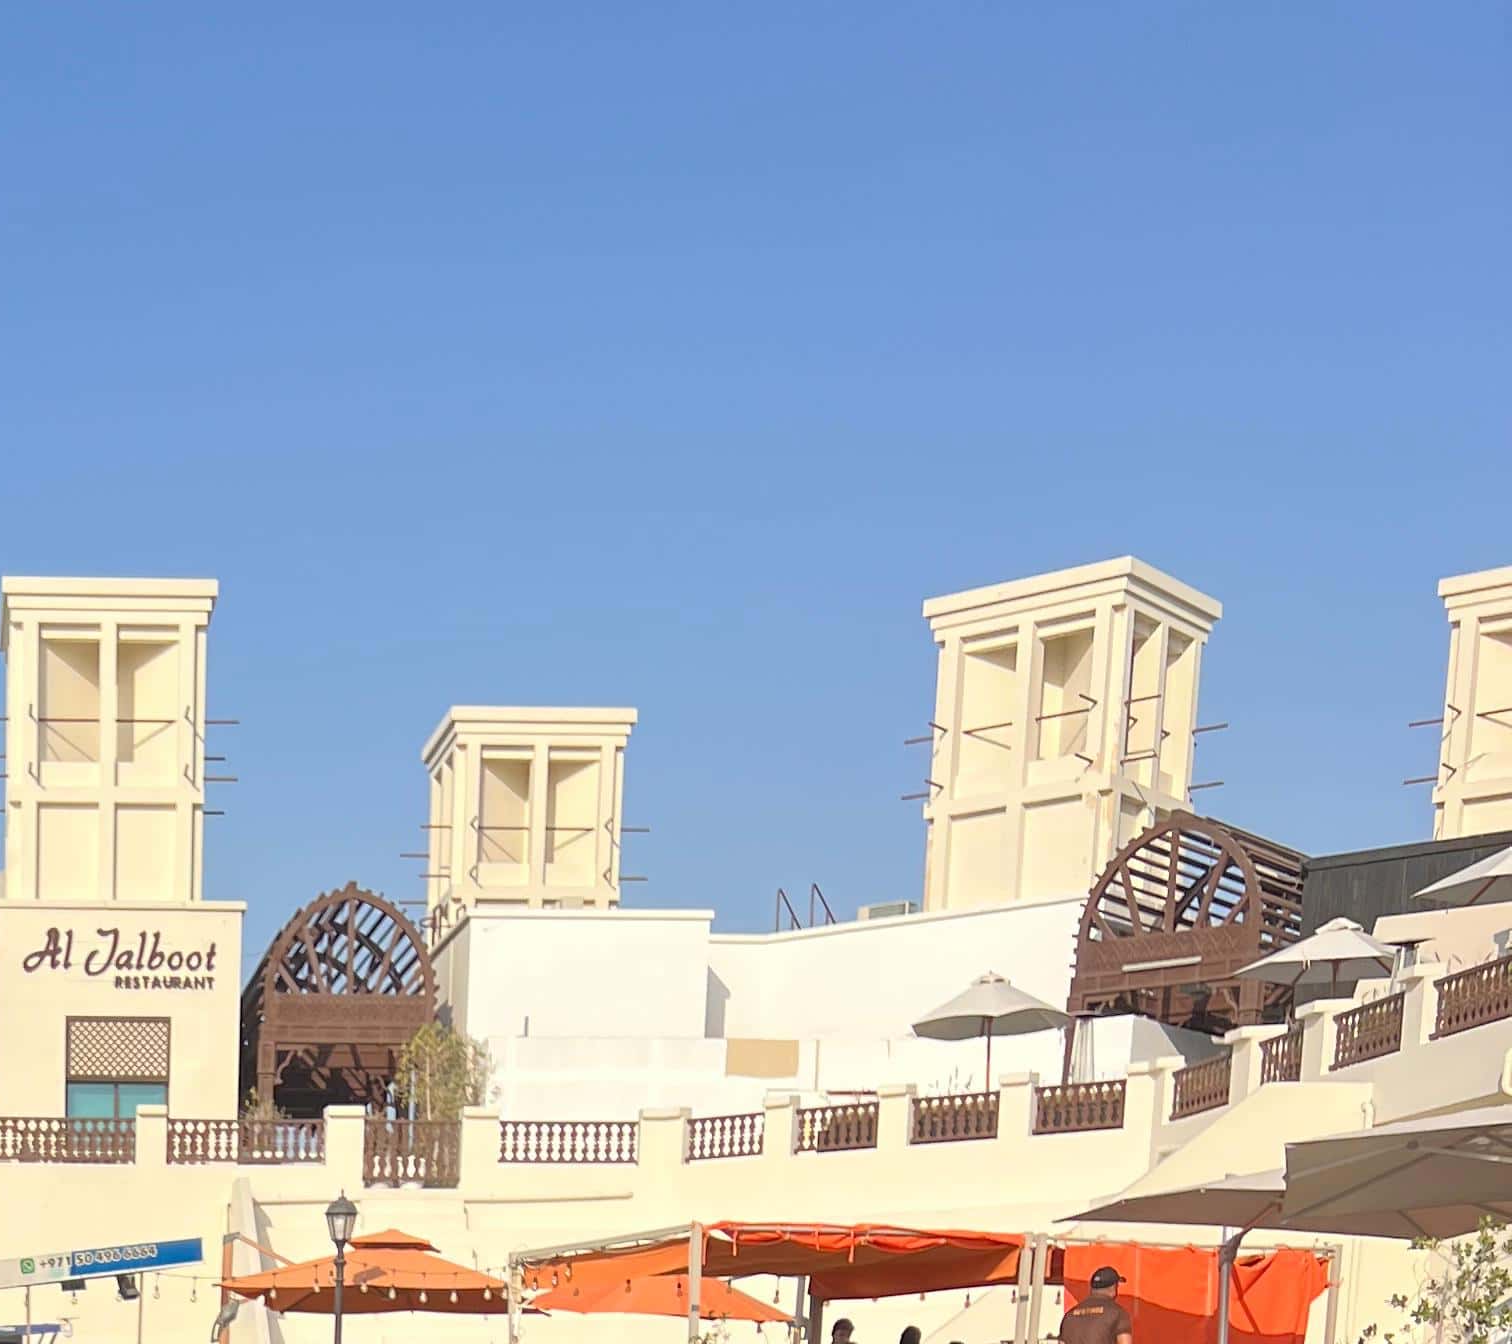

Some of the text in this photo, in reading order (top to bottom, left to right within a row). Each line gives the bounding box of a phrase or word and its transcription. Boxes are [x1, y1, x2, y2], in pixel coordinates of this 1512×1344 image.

[22, 926, 218, 977] Al Jalboot
[114, 975, 216, 991] RESTAURANT
[40, 1256, 71, 1268] +971
[75, 1253, 93, 1266] 50
